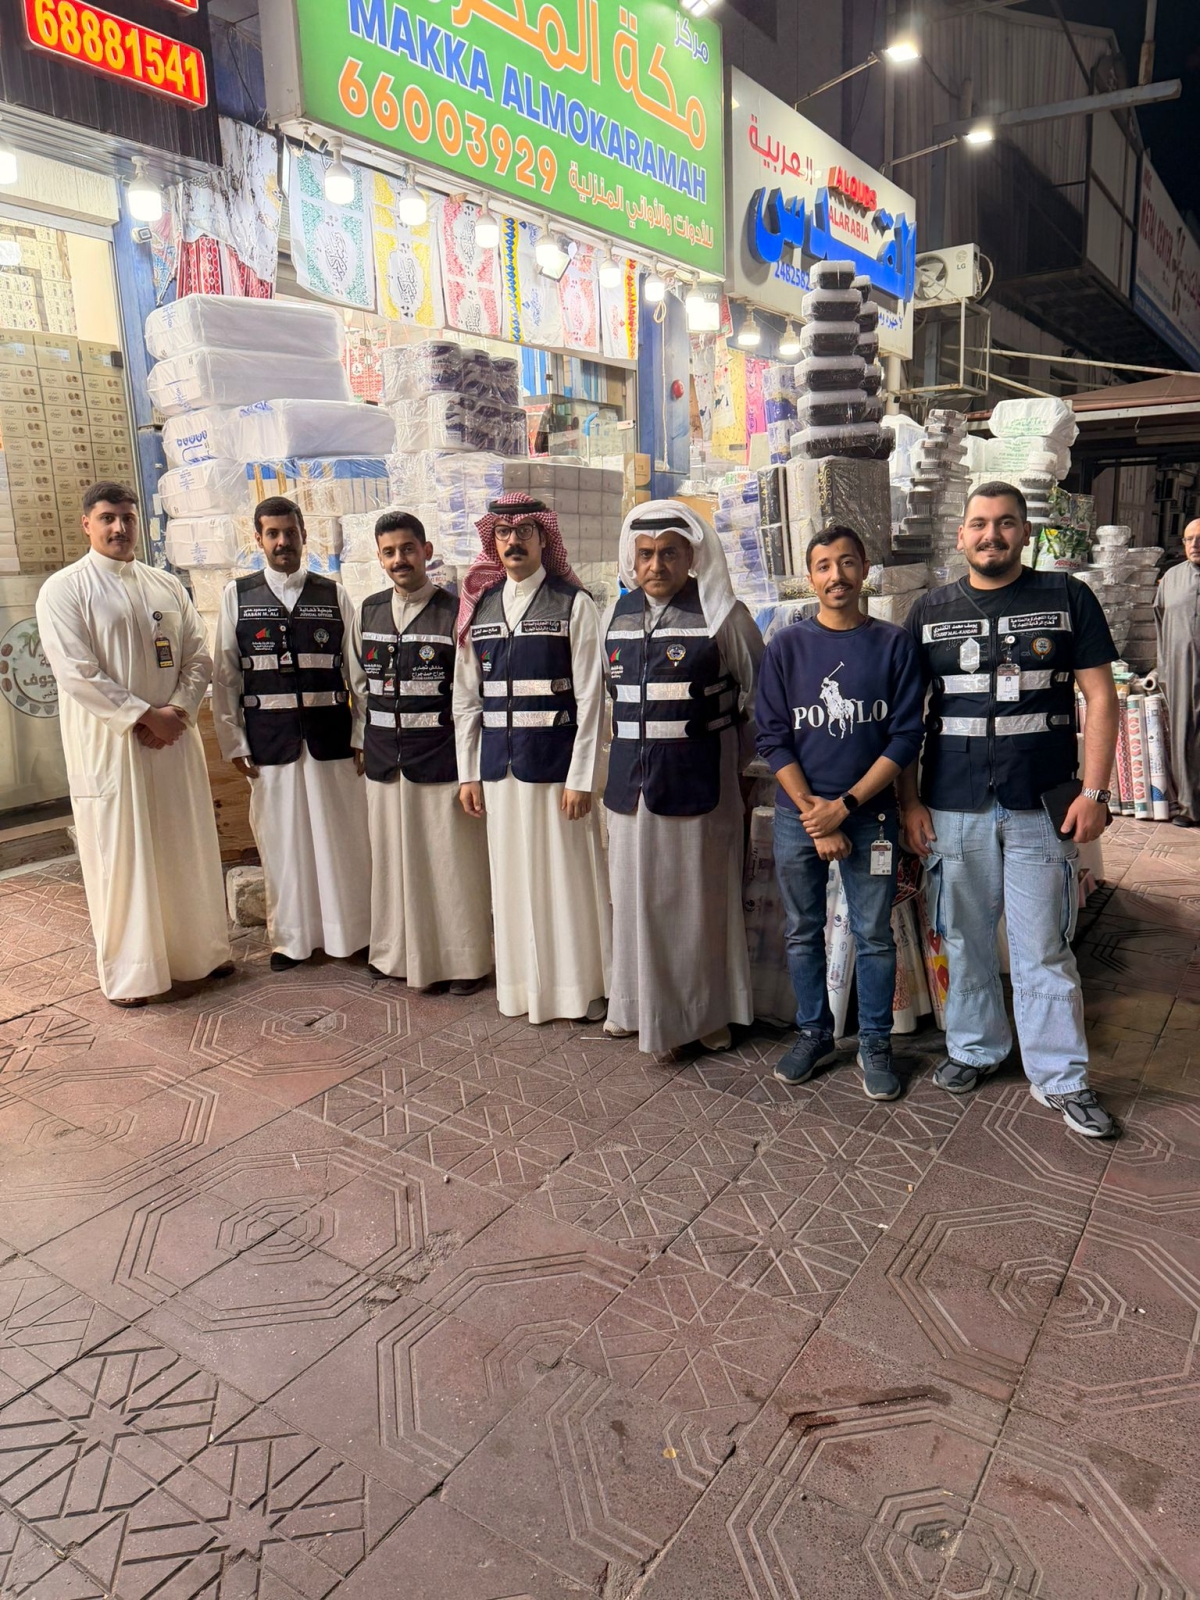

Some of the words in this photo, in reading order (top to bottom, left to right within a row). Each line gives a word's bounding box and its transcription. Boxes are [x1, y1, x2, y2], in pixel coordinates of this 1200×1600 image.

[34, 0, 201, 98] 68881541
[427, 0, 601, 85] المكر
[674, 11, 709, 64] مركز
[348, 0, 495, 102] MAKKA
[501, 62, 707, 205] ALMOKARAMAH
[613, 5, 707, 150] مكة
[338, 56, 558, 195] 66003929
[748, 113, 813, 186] العربية
[568, 160, 624, 212] المنزلية
[828, 165, 878, 212] ALQUDS
[828, 204, 870, 245] ALARABIA
[774, 260, 814, 292] 2482582
[792, 699, 889, 730] POLO
